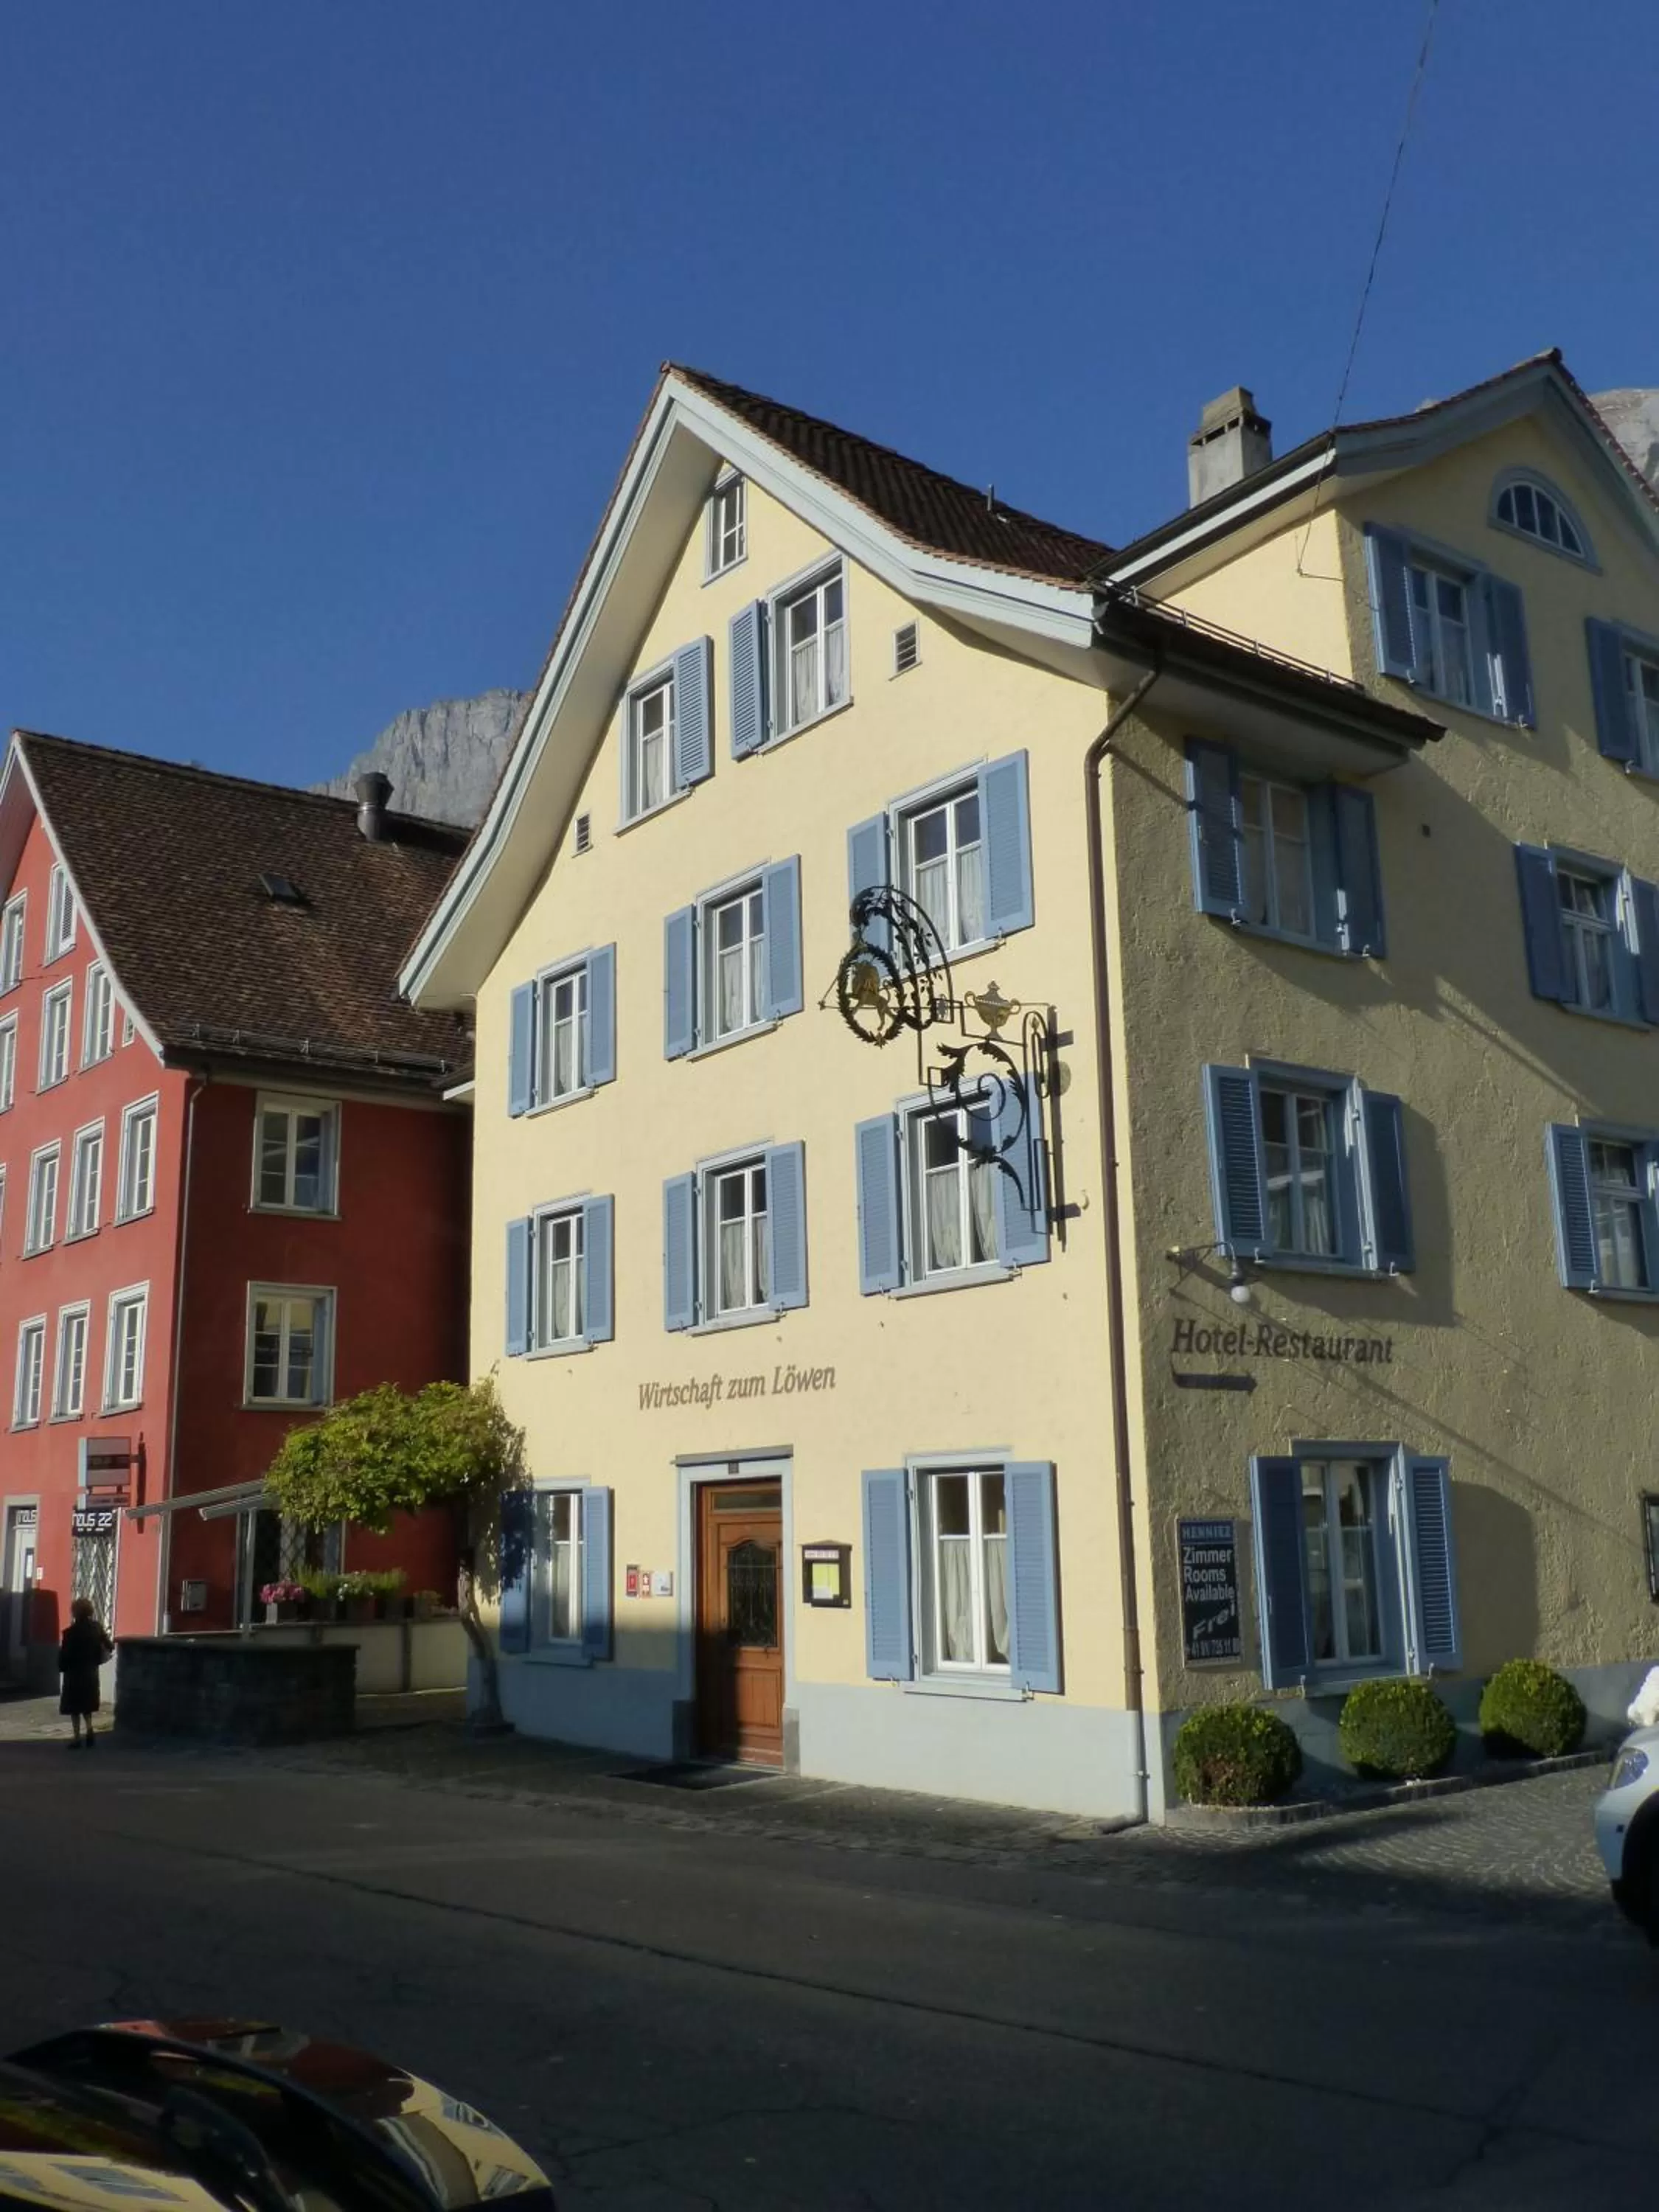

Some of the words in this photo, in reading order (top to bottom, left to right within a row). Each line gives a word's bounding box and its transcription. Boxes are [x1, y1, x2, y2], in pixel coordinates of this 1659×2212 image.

[1172, 1318, 1393, 1363] Hotel-Restaurant
[639, 1374, 723, 1411] Wirtschaft
[727, 1374, 765, 1400] zum
[771, 1364, 835, 1395] Löwen
[1183, 1546, 1234, 1564] Zimmer
[1183, 1566, 1227, 1584] Rooms
[1185, 1583, 1236, 1602] Available
[1193, 1599, 1236, 1641] Frei
